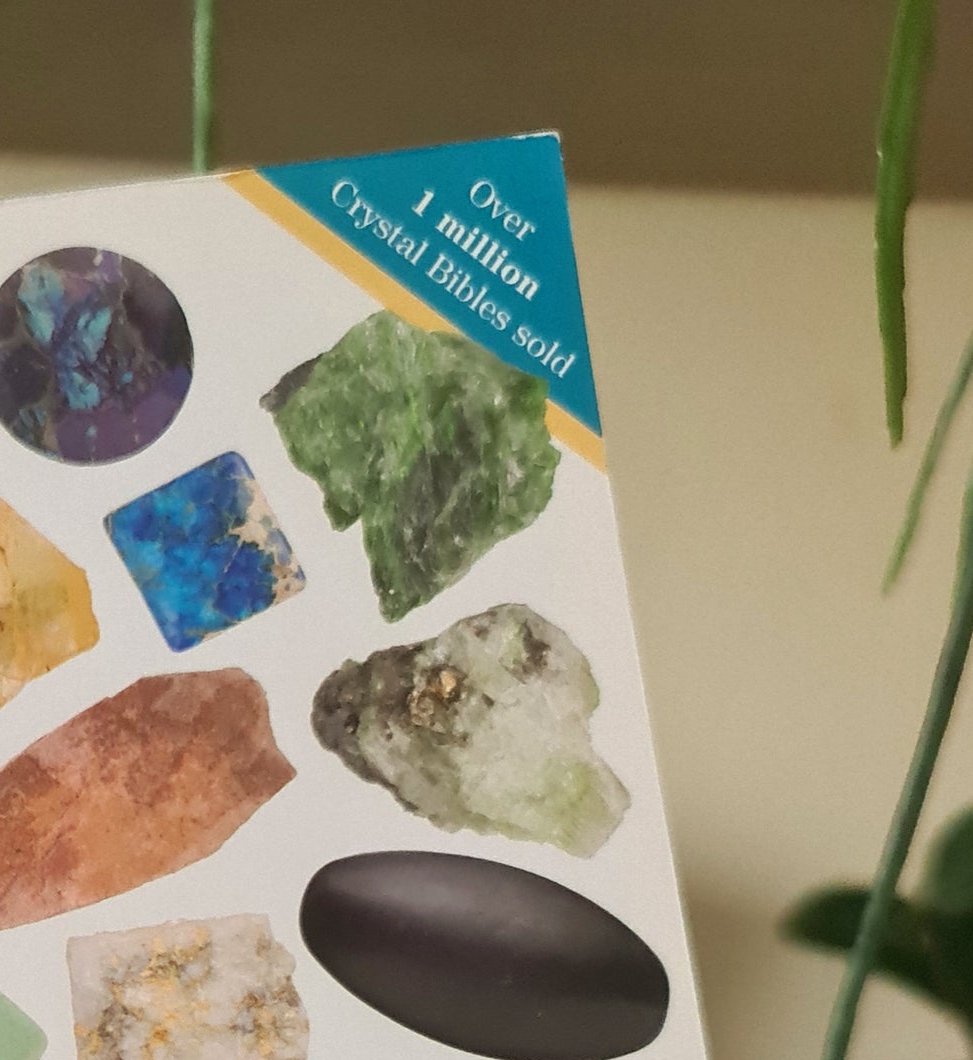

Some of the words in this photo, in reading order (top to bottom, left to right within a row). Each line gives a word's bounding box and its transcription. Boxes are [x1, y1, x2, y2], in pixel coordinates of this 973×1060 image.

[411, 191, 435, 217] 1
[436, 212, 540, 300] million
[469, 179, 536, 242] Over
[331, 180, 429, 266] Crystal
[426, 254, 511, 331] Bibles
[512, 324, 577, 378] sold
